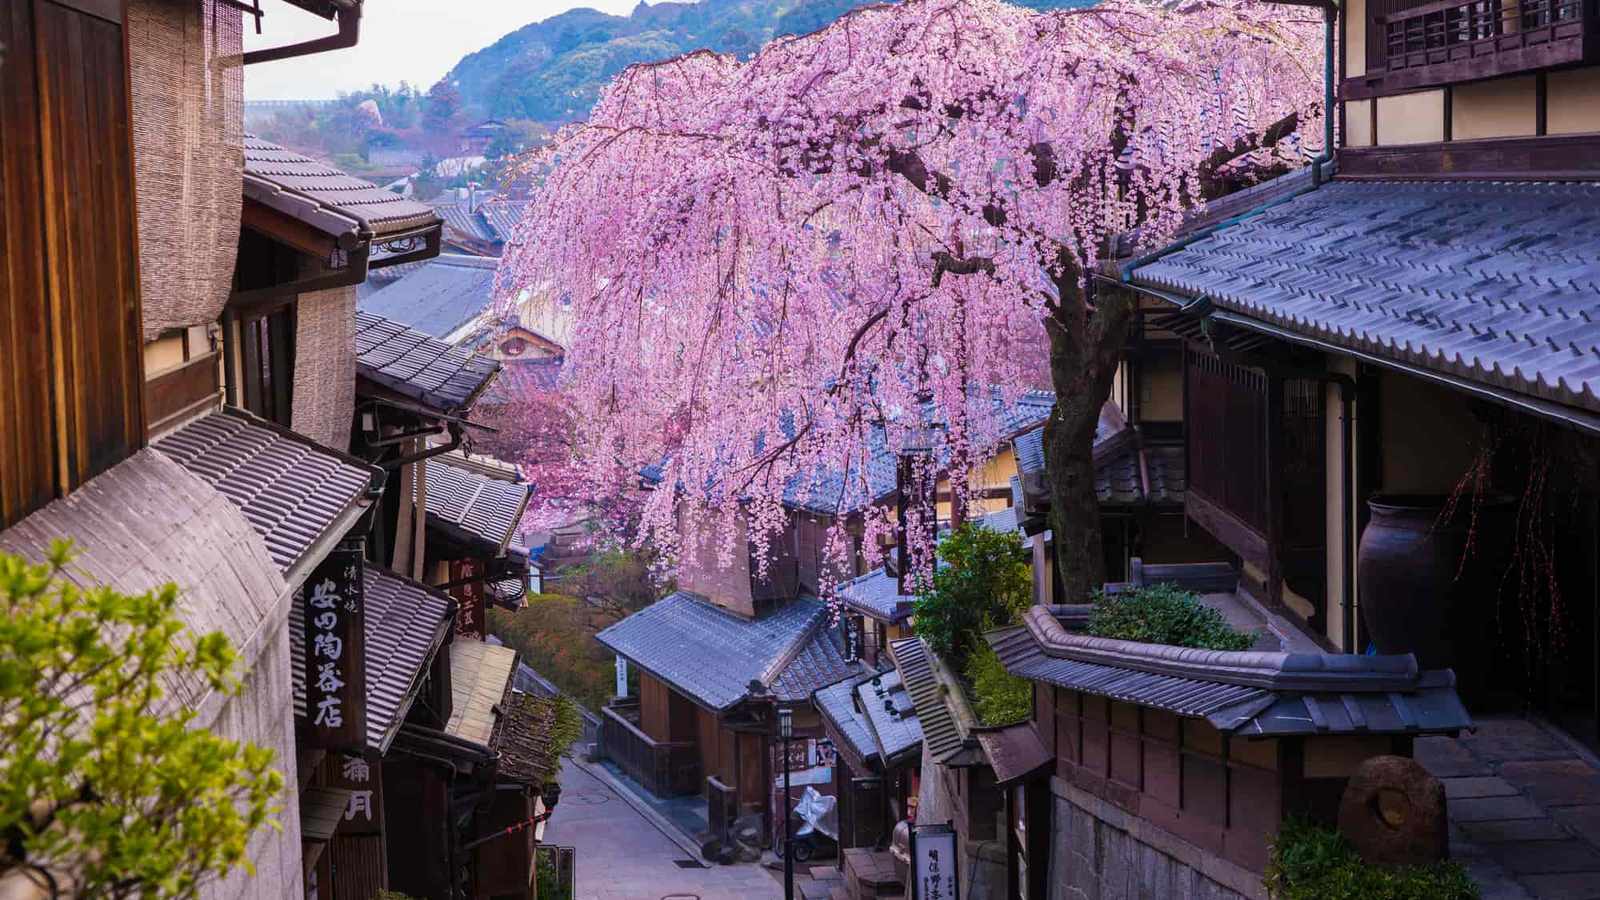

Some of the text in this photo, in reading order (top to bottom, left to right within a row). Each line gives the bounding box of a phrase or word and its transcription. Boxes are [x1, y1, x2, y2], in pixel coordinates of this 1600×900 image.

[309, 576, 346, 729] 安田陶器店
